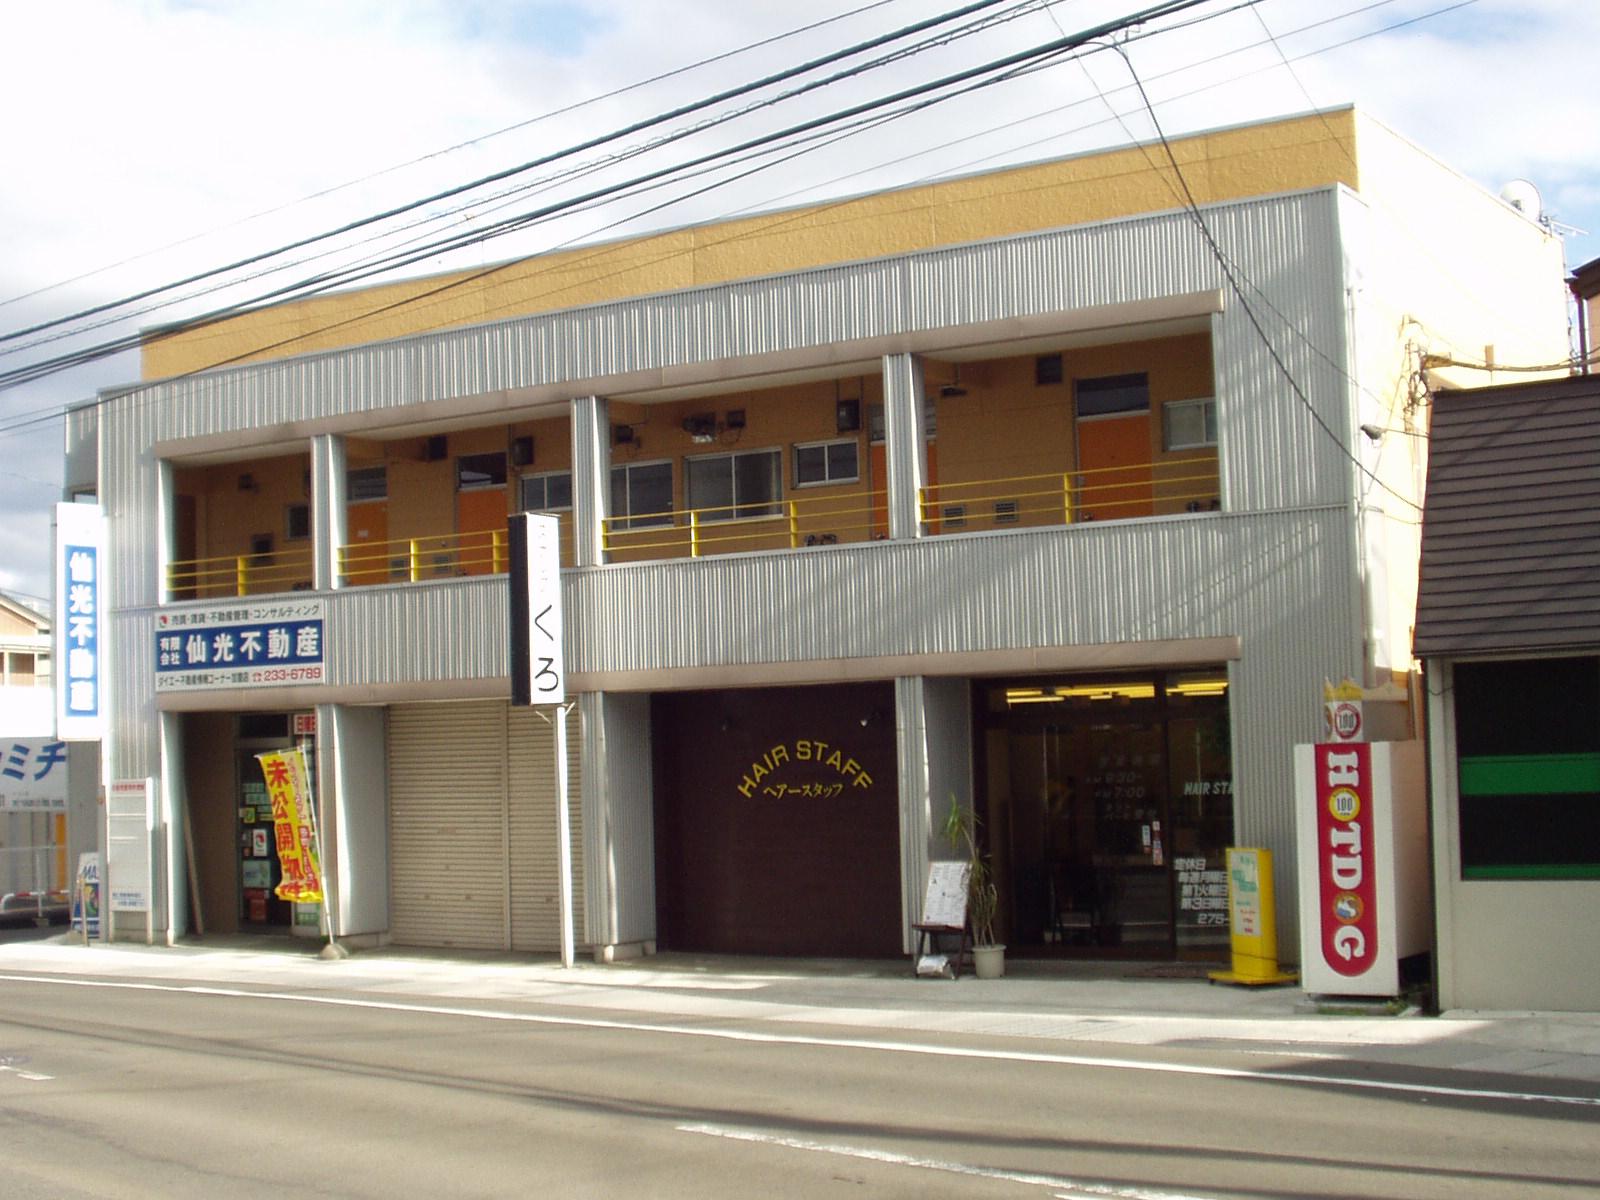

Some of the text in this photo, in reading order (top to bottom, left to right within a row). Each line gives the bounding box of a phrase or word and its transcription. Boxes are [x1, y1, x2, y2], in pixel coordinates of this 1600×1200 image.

[186, 627, 319, 663] 仙光不動産
[264, 667, 321, 682] 233-6789
[0, 741, 66, 781] ミチ
[737, 740, 873, 798] HAIR STAFF
[763, 782, 844, 799] ヘアースタッフ
